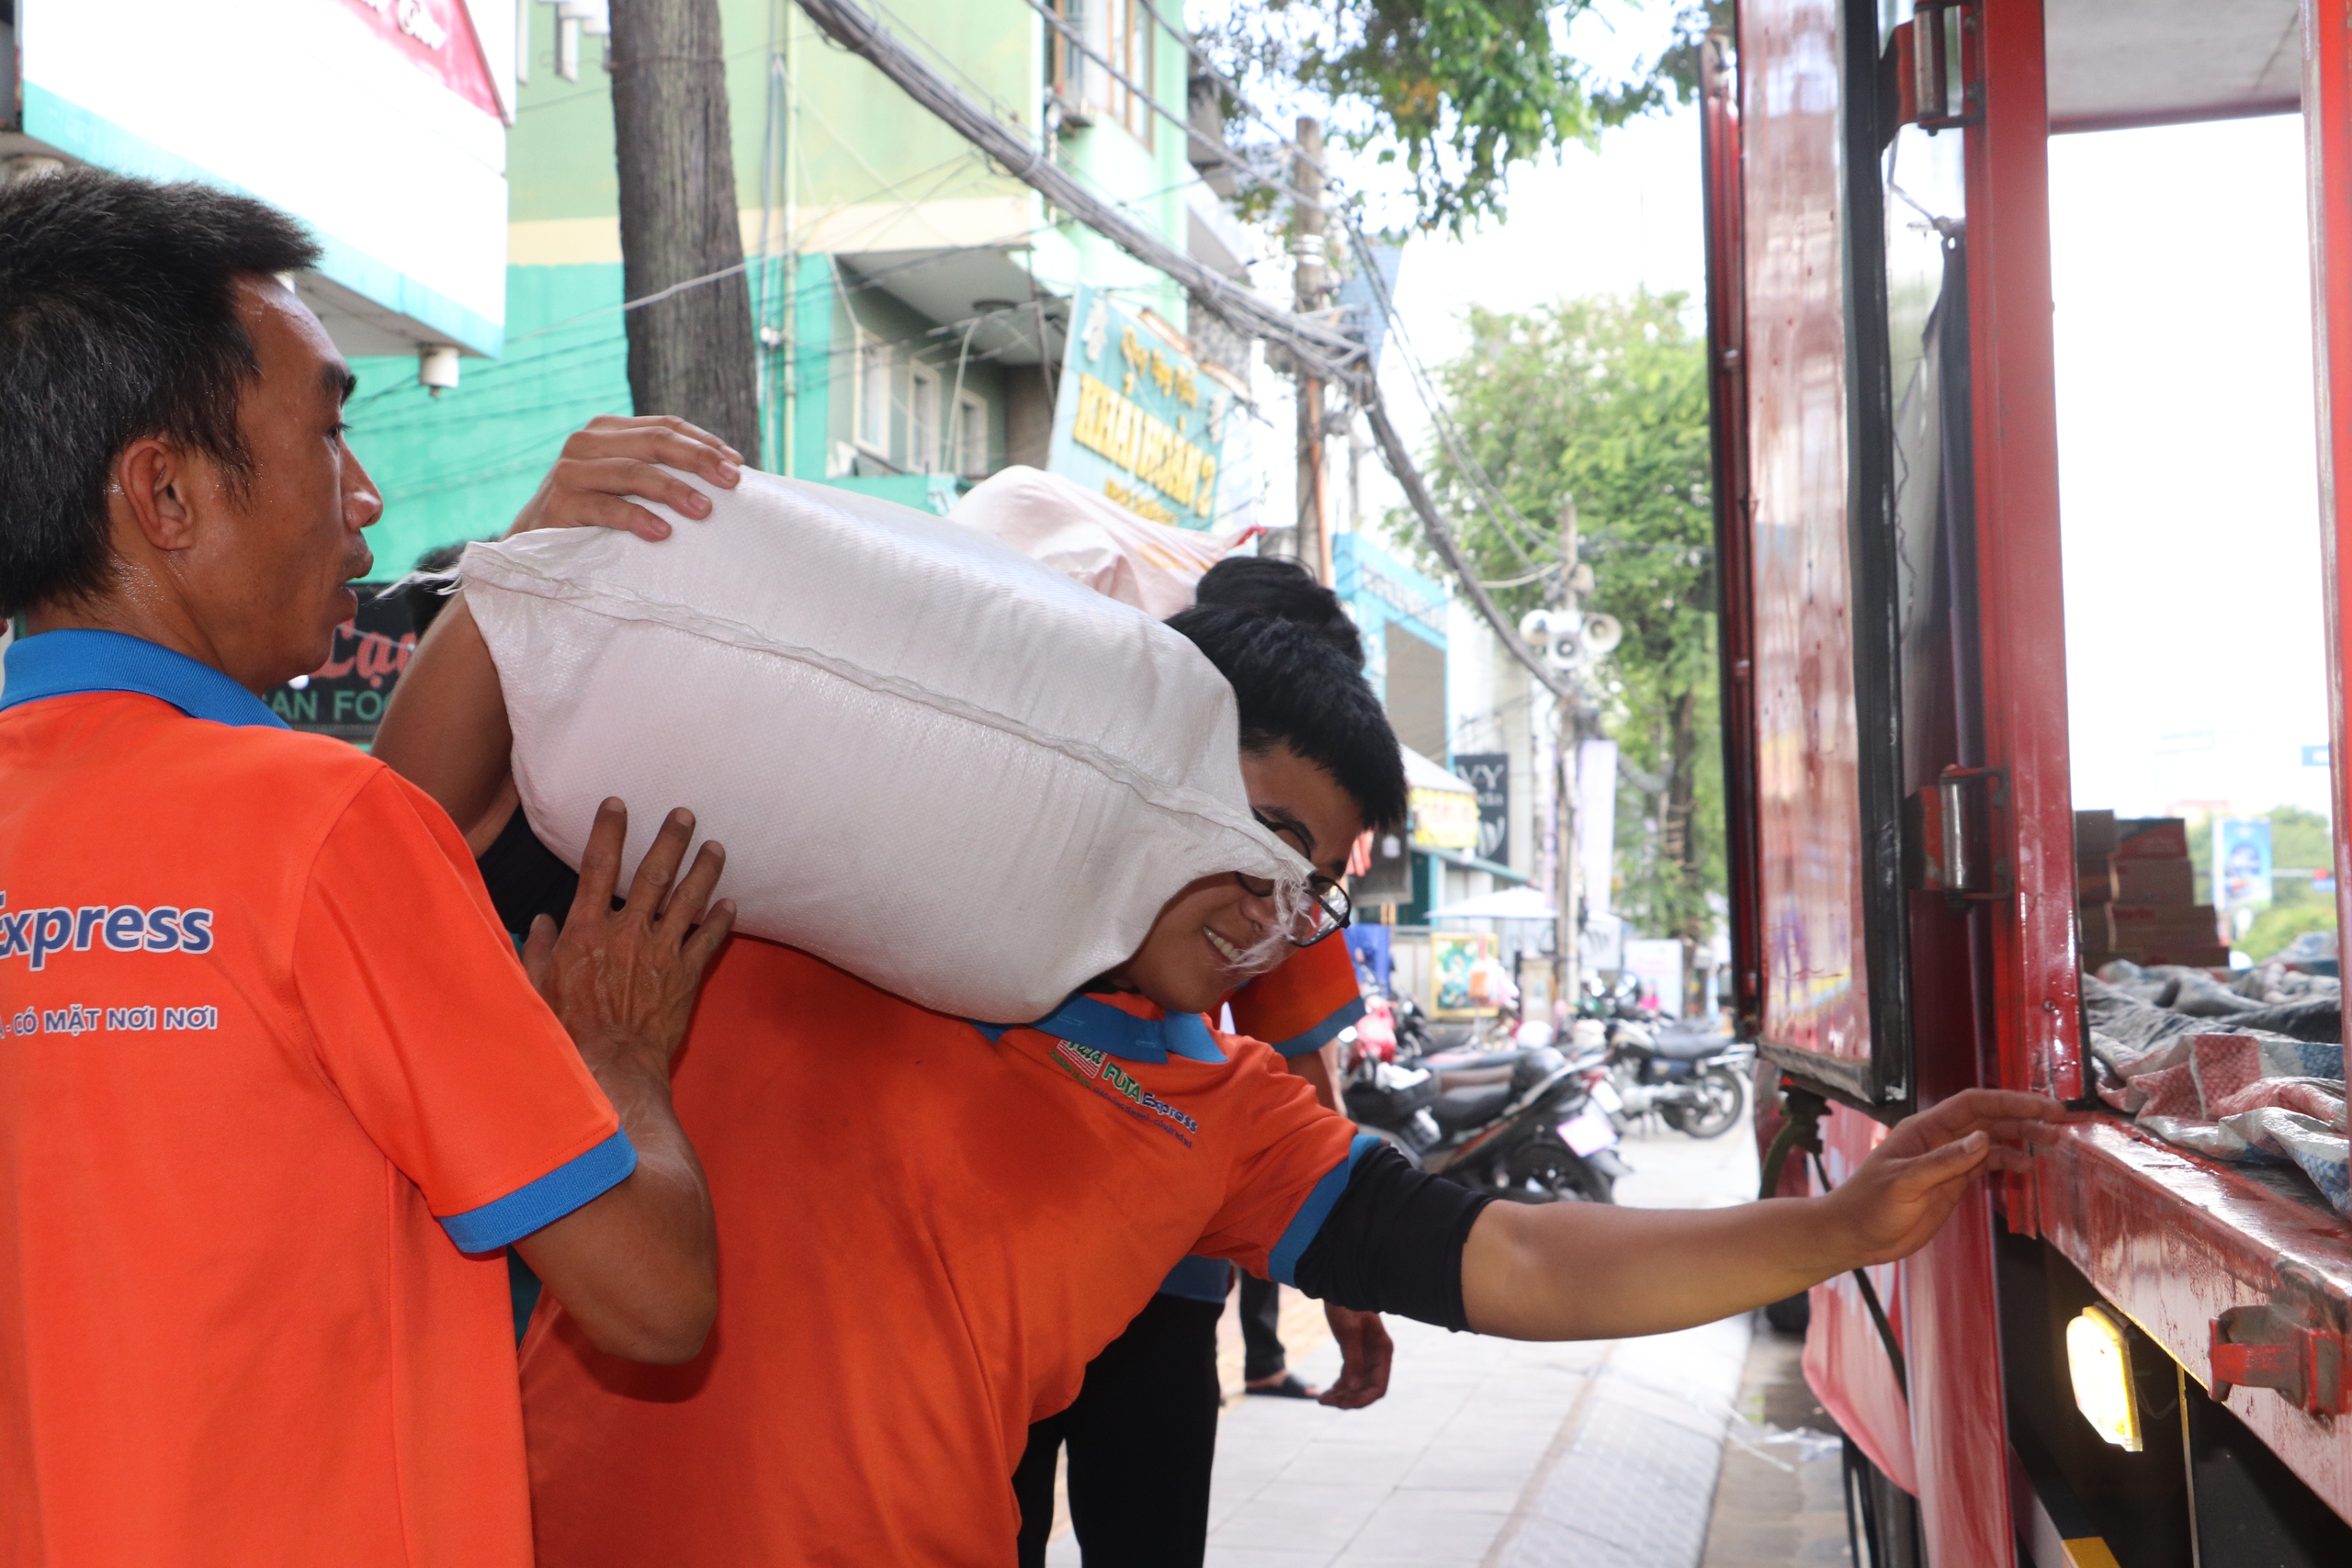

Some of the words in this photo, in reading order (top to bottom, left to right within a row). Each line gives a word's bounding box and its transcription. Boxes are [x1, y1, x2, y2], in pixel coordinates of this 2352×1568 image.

[262, 691, 318, 722] AN
[334, 691, 390, 722] FO
[44, 1004, 102, 1037] MẶT
[107, 1006, 156, 1031] NƠI
[164, 1005, 218, 1030] NƠI
[1102, 1062, 1142, 1104] FUTA
[1142, 1091, 1198, 1134] Express
